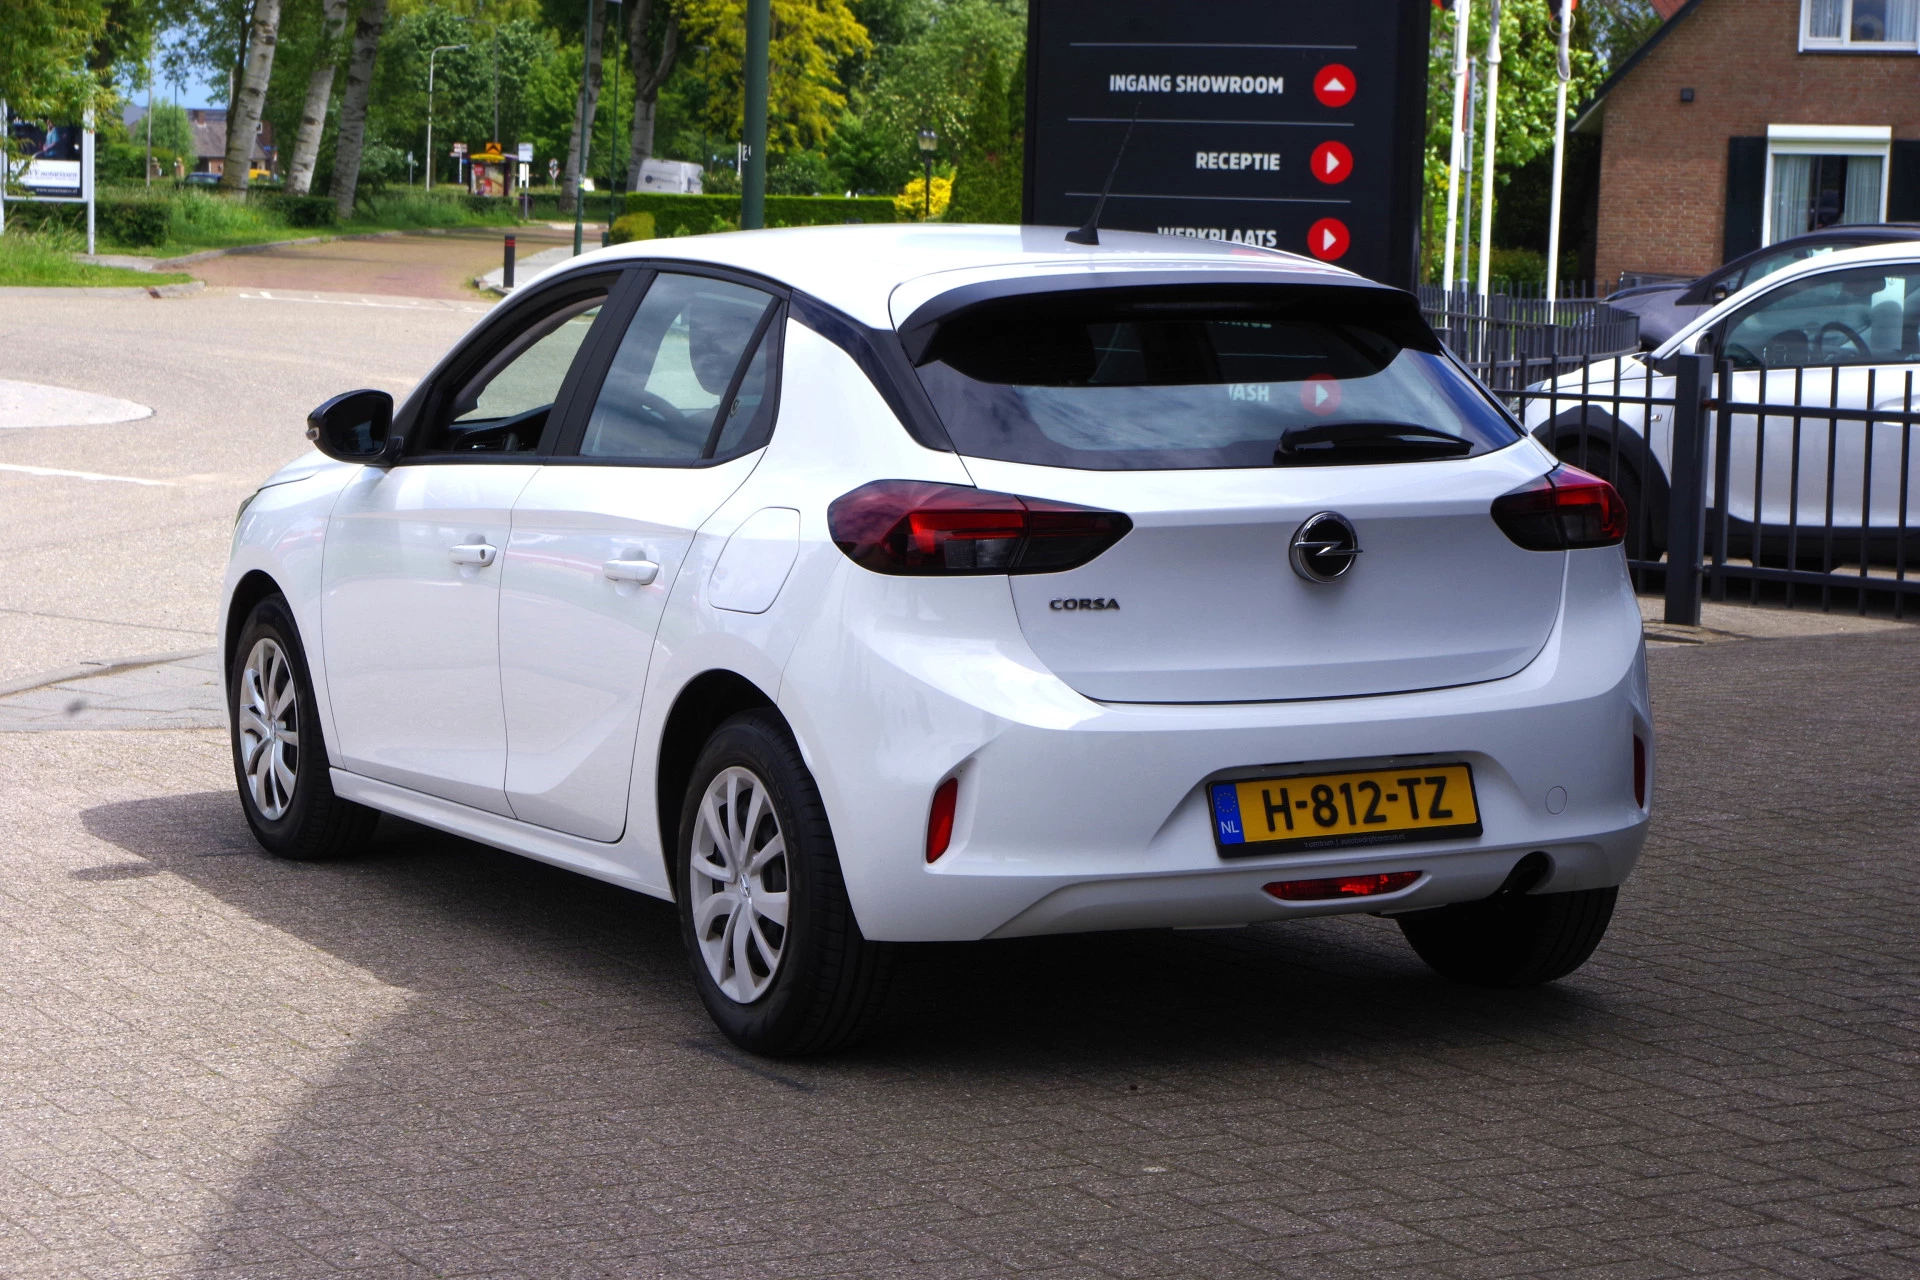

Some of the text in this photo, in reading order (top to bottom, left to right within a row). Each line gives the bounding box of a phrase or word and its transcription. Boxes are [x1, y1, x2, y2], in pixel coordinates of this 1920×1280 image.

[1109, 74, 1284, 95] INGANG SHOWROOM
[1196, 152, 1280, 171] RECEPTIE
[1049, 597, 1121, 611] CORSA
[1261, 775, 1454, 832] H-812-TZ
[1220, 820, 1240, 834] NL
